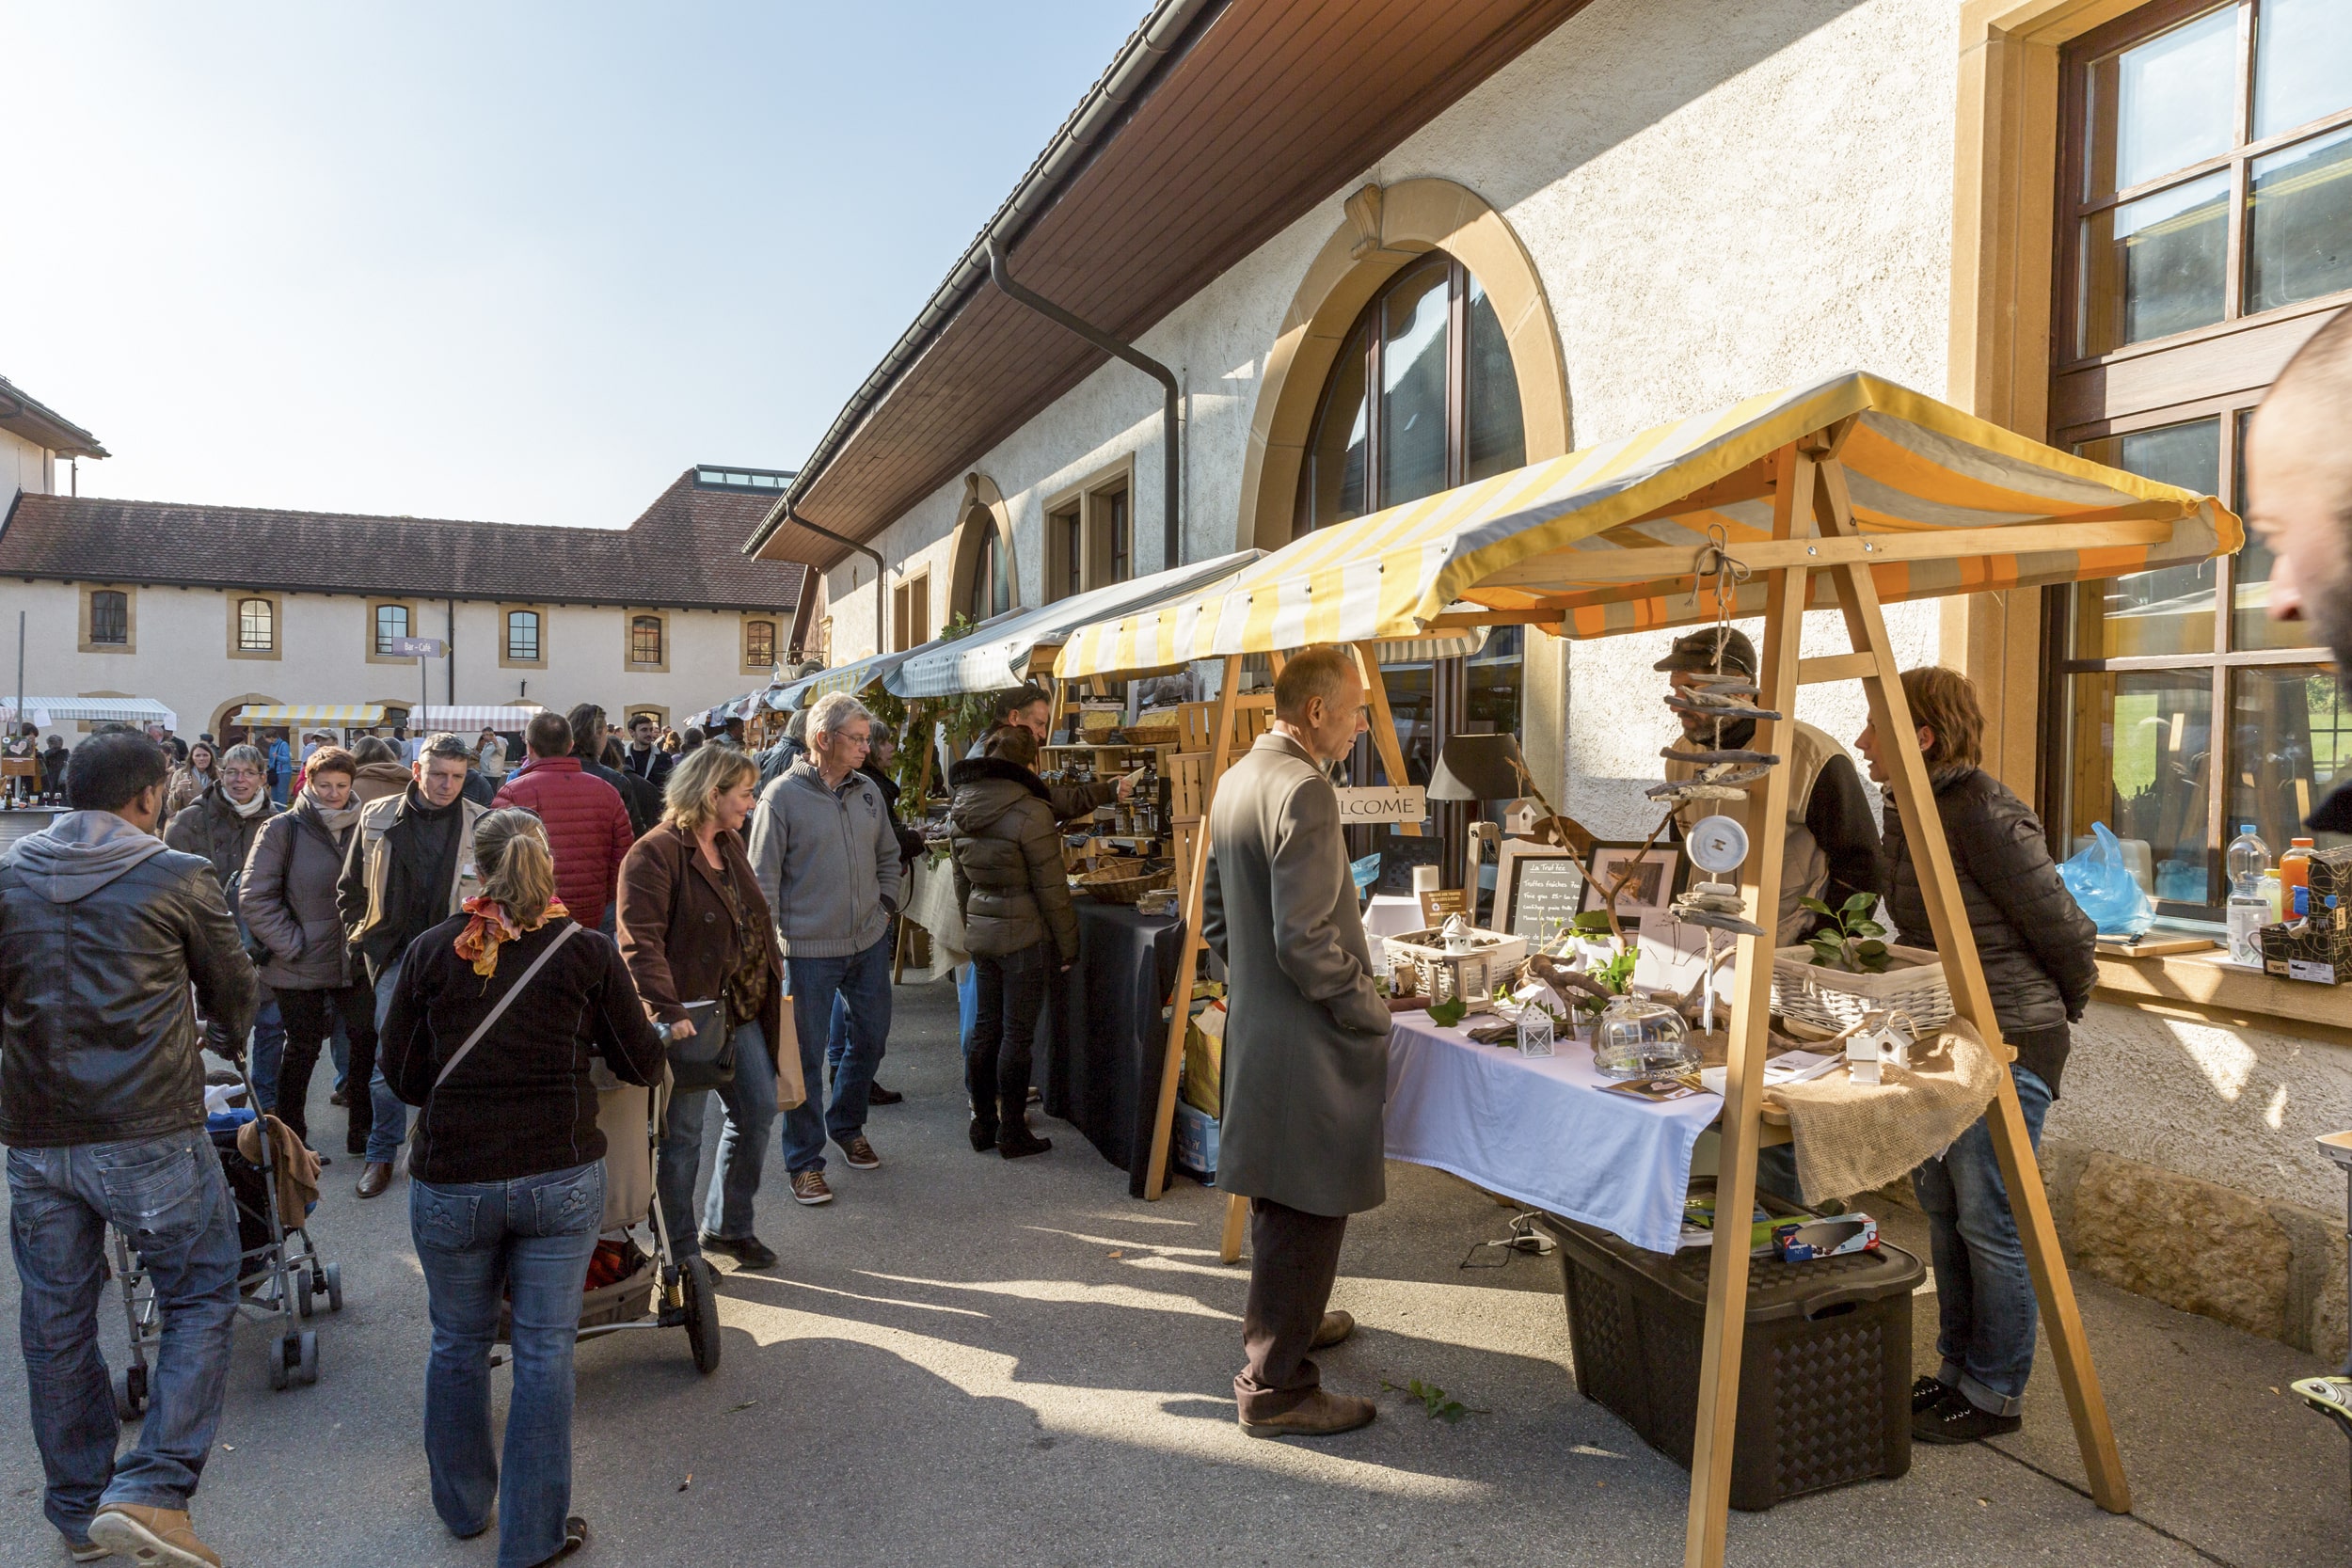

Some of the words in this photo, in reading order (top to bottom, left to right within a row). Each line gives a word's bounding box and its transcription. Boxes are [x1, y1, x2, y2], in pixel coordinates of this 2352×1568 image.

[405, 641, 414, 650] Bar
[419, 642, 431, 652] Café
[1337, 799, 1414, 815] LCOME
